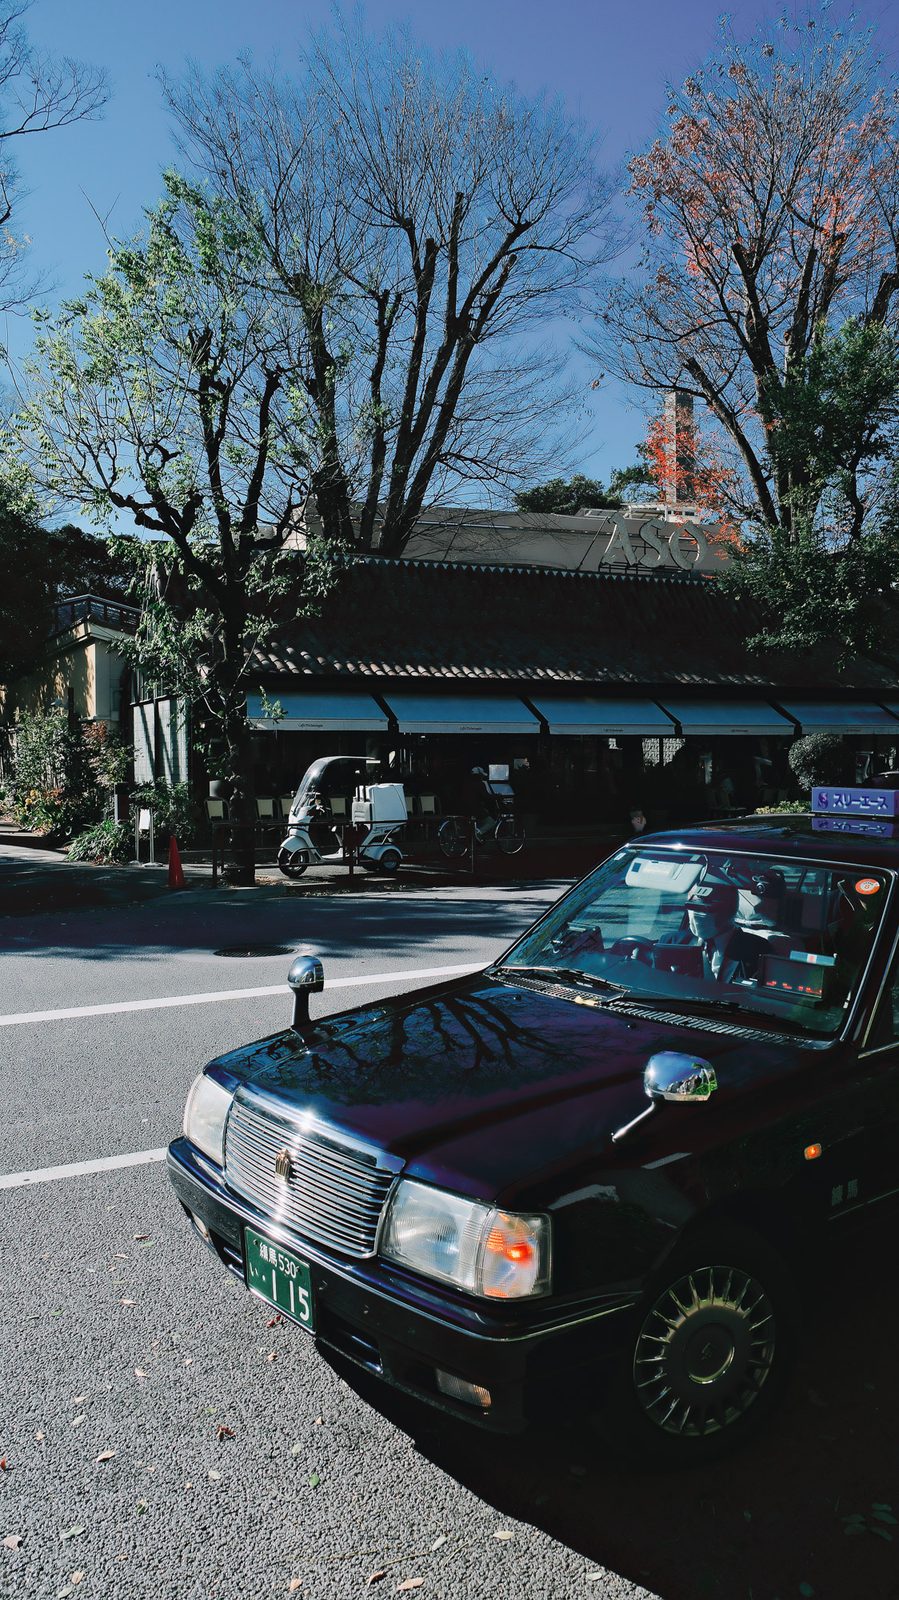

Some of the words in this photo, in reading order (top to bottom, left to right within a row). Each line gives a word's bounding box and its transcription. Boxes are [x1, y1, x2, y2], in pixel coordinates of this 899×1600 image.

[600, 511, 707, 571] ASO
[833, 793, 889, 810] スリーエース
